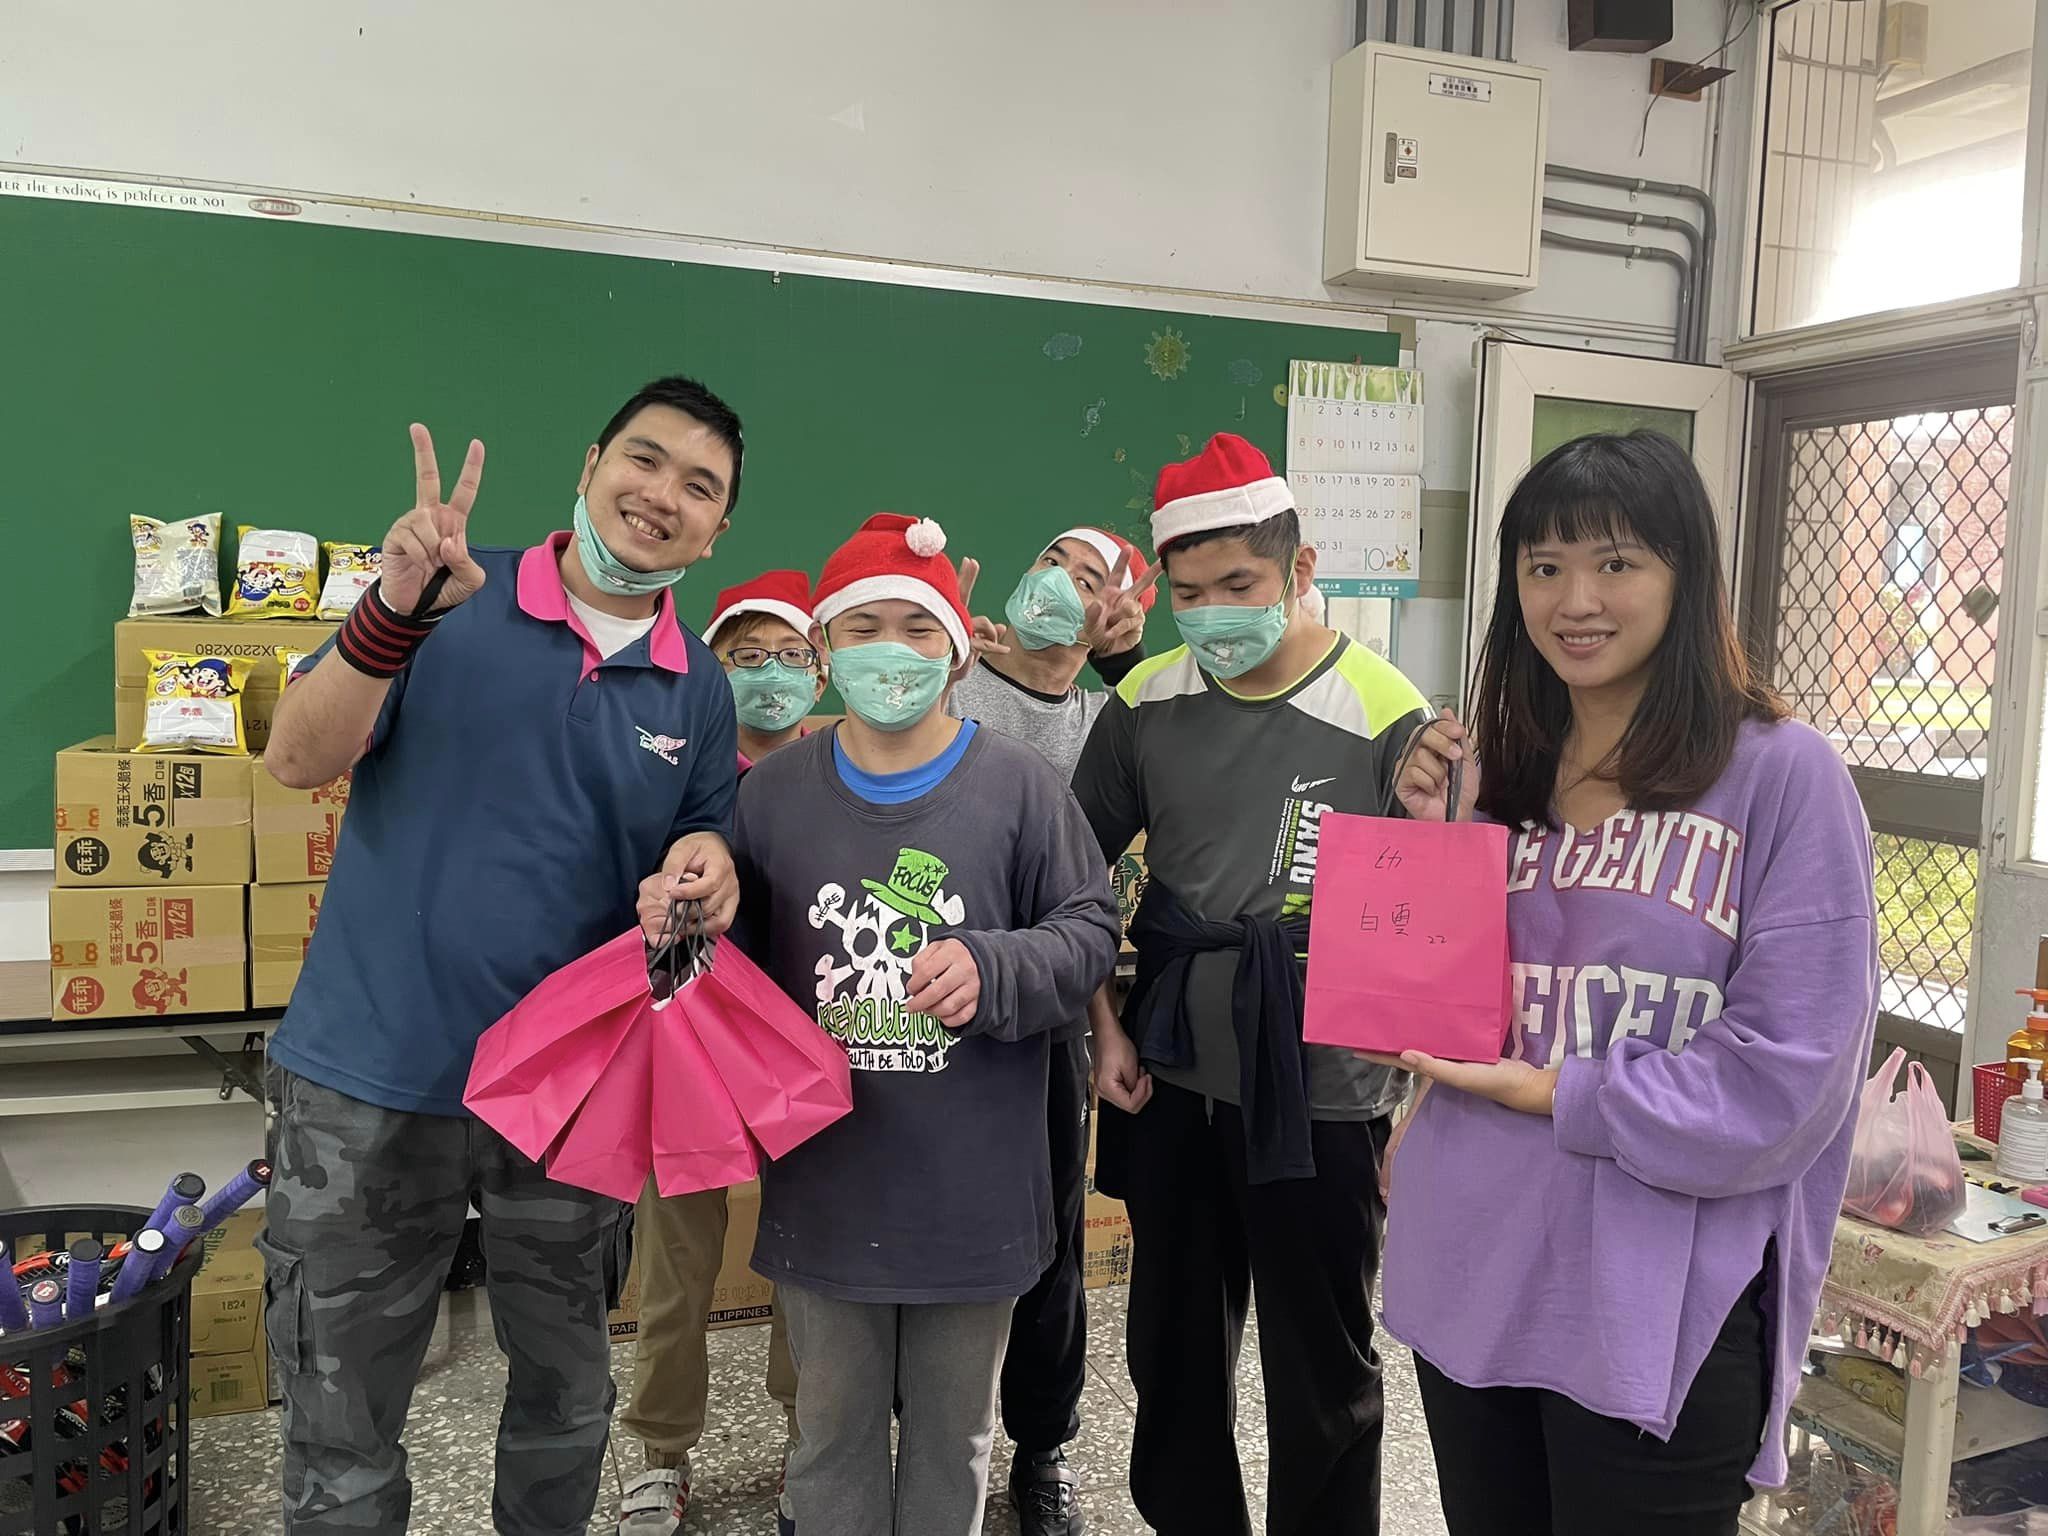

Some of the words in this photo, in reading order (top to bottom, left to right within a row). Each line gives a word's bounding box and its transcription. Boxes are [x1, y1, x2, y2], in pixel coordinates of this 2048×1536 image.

[180, 195, 198, 206] OR
[1299, 438, 1306, 447] 8
[1317, 438, 1324, 448] 9
[1333, 439, 1345, 449] 10
[1351, 440, 1361, 449] 11
[1369, 441, 1380, 451] 12
[1387, 442, 1398, 452] 13
[1404, 443, 1415, 453] 14
[1296, 474, 1309, 484] 15
[1314, 475, 1326, 484] 16
[1332, 475, 1343, 485] 17
[1349, 476, 1361, 486] 18
[1367, 477, 1377, 486] 19
[1383, 478, 1395, 487] 20
[1400, 478, 1410, 487] 21
[1296, 507, 1309, 516] 22
[1314, 507, 1326, 517] 23
[1331, 508, 1344, 518] 24
[1349, 509, 1361, 518] 25
[1366, 509, 1378, 519] 26
[1383, 510, 1395, 519] 27
[1400, 510, 1412, 520] 28
[1314, 541, 1326, 550] 30
[1331, 541, 1343, 550] 31
[1364, 547, 1385, 571] 10
[76, 839, 98, 873] 乖乖
[892, 866, 938, 897] FOCUS
[814, 892, 842, 922] HERE
[71, 979, 93, 1013] 乖乖
[849, 1050, 875, 1069] RUTH
[878, 1053, 894, 1069] BE
[900, 1050, 924, 1070] TOLD
[609, 1322, 637, 1335] PAR
[709, 1306, 769, 1322] HILIPPINES
